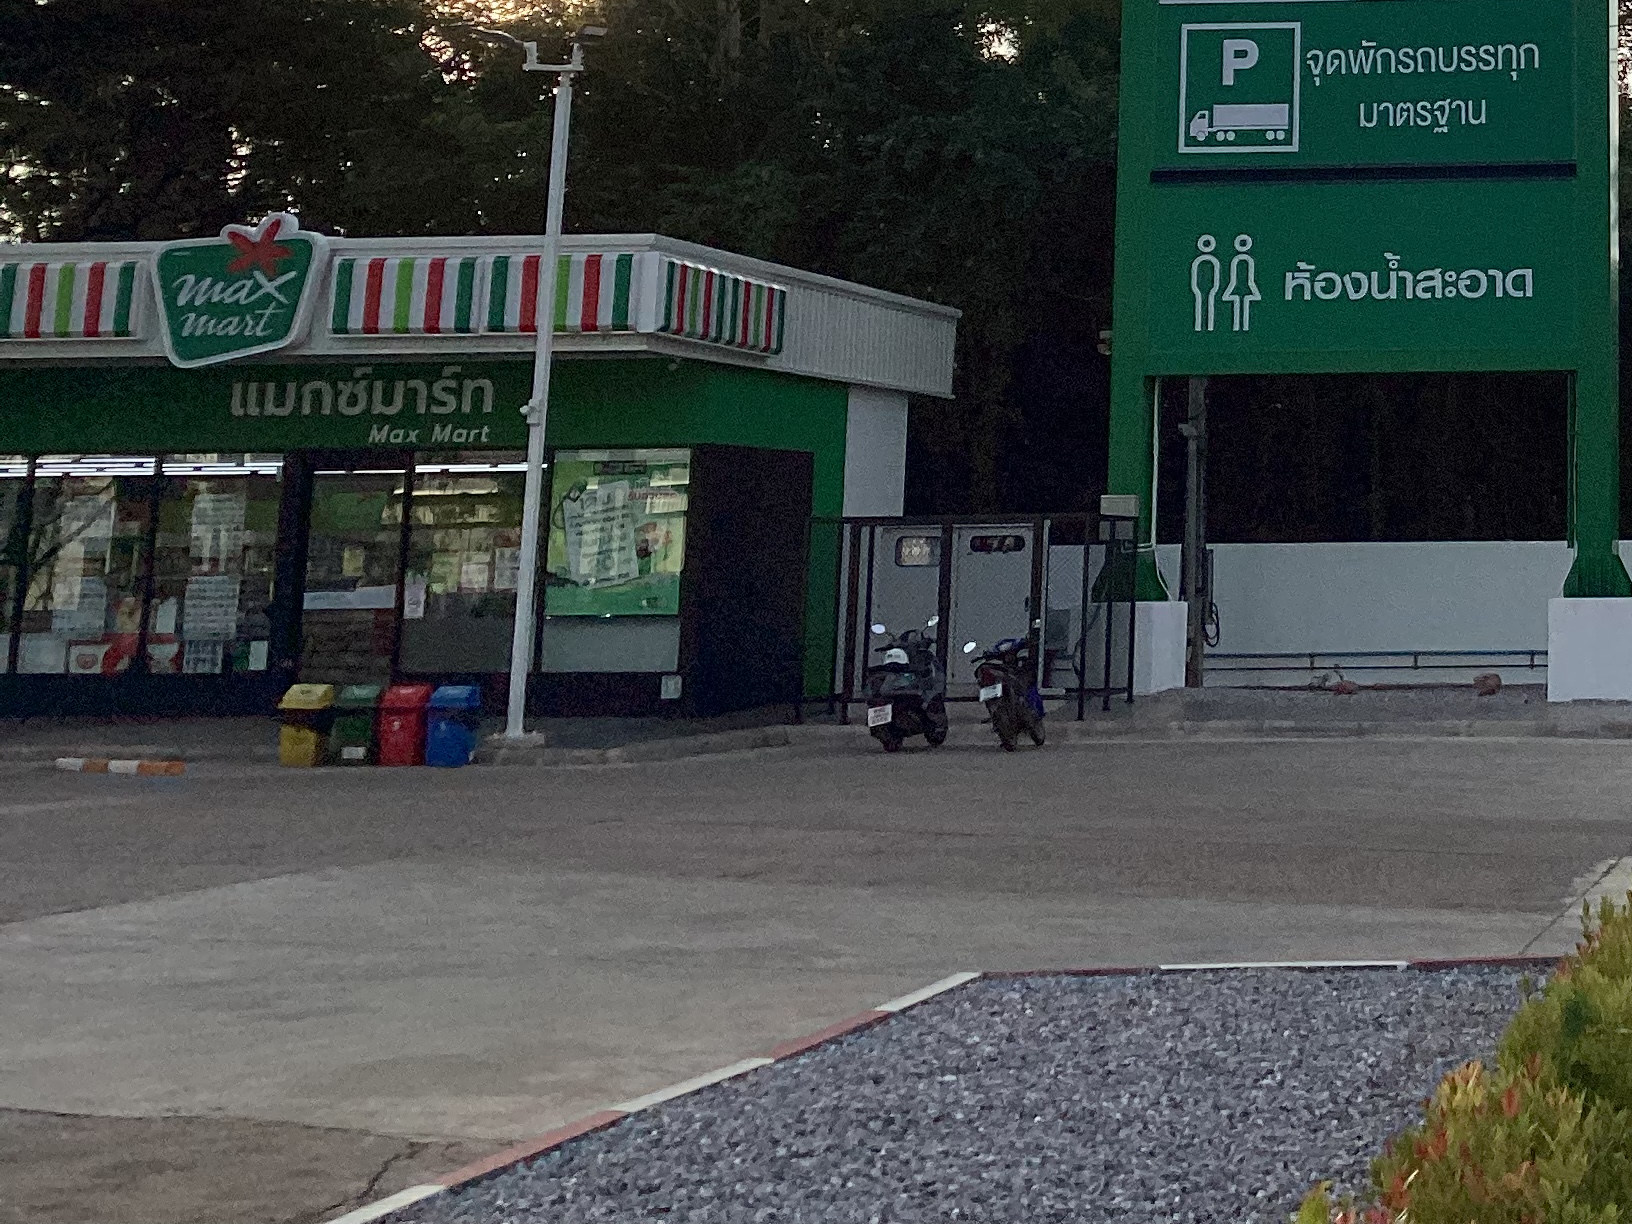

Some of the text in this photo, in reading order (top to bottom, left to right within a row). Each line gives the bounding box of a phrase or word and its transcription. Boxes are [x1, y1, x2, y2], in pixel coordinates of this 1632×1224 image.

[1222, 38, 1260, 86] P
[1306, 39, 1540, 87] จุดพักรถบรรทุก
[1358, 98, 1487, 134] มาตรฐาน
[1284, 252, 1534, 301] ห้องน้ำสะอาด
[180, 302, 285, 337] mart
[230, 365, 495, 416] แมกซ์มาร์ท
[368, 424, 491, 444] Max Mart
